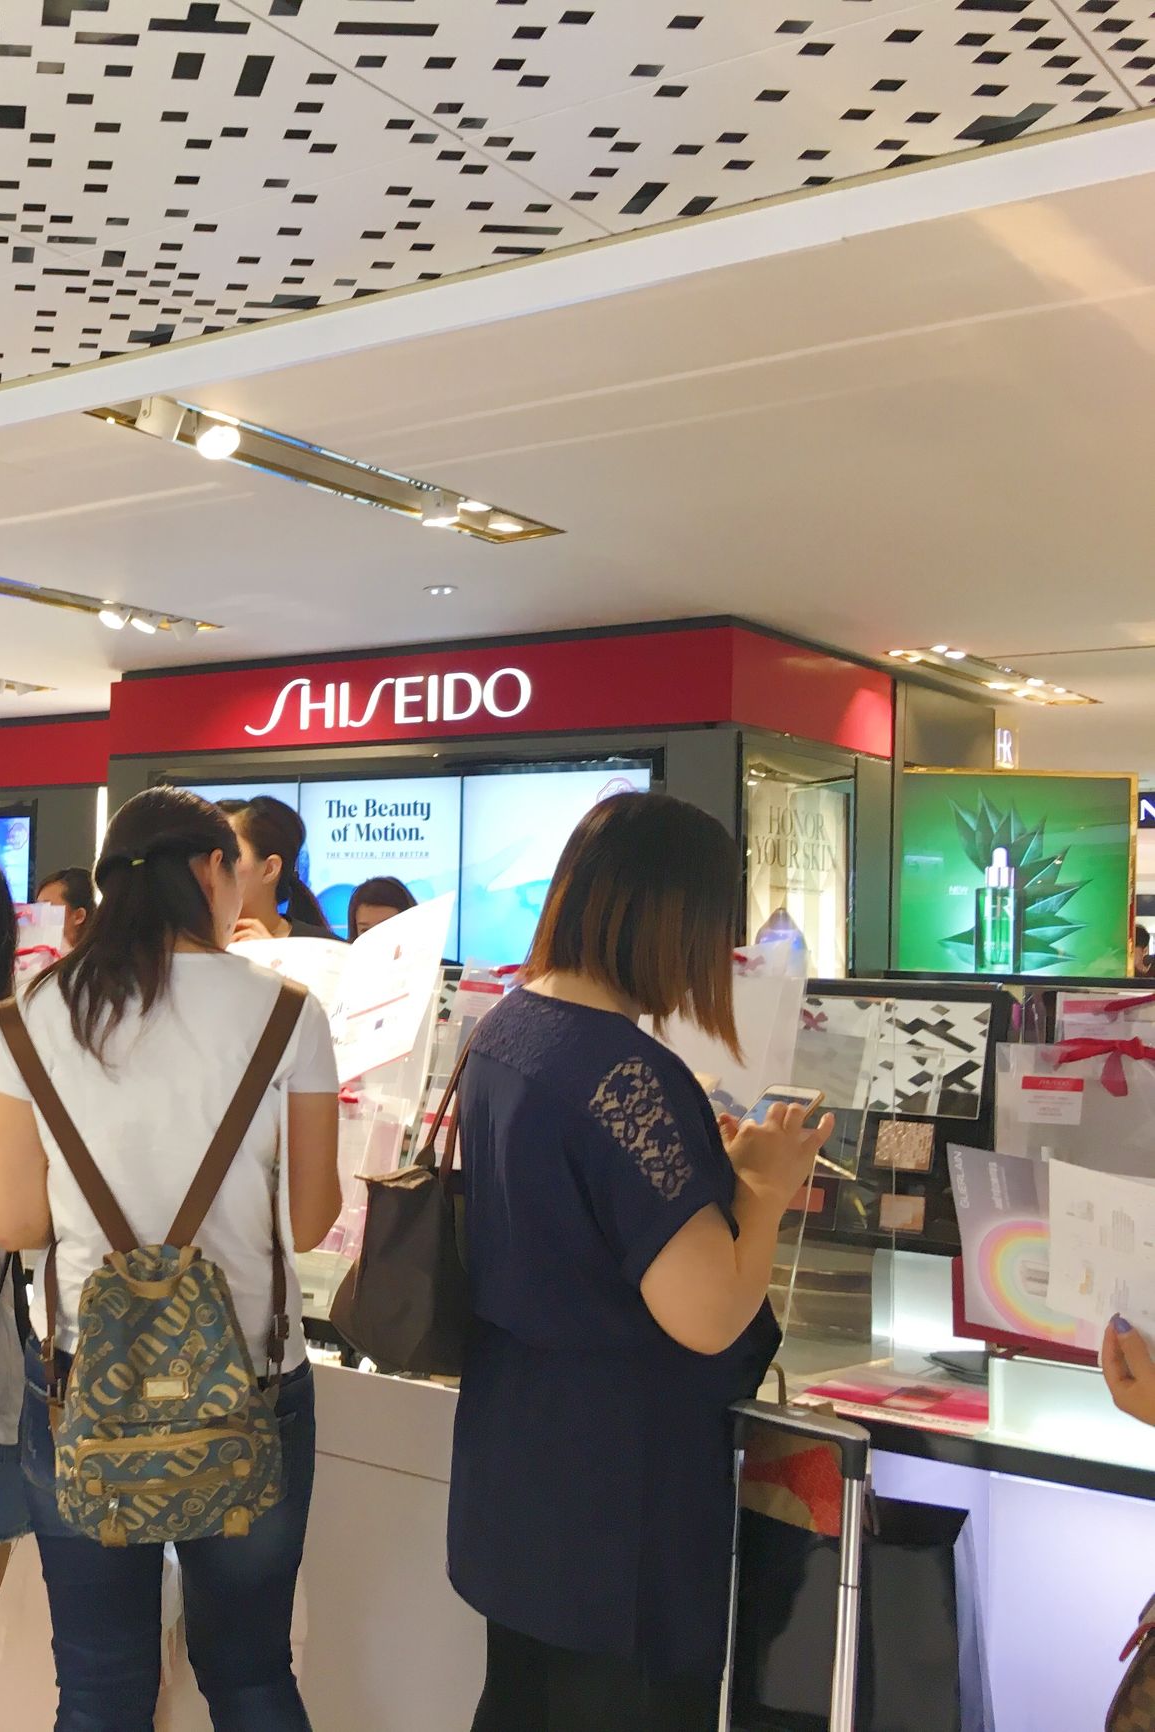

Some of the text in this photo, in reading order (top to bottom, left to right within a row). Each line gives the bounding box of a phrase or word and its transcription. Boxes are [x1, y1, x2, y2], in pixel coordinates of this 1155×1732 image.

[244, 667, 531, 736] SHISEIDO
[996, 728, 1014, 764] HR
[325, 799, 431, 821] The Beauty
[768, 806, 826, 840] HONOR
[331, 822, 425, 842] of Motion.
[754, 836, 839, 873] YOUR SKIN
